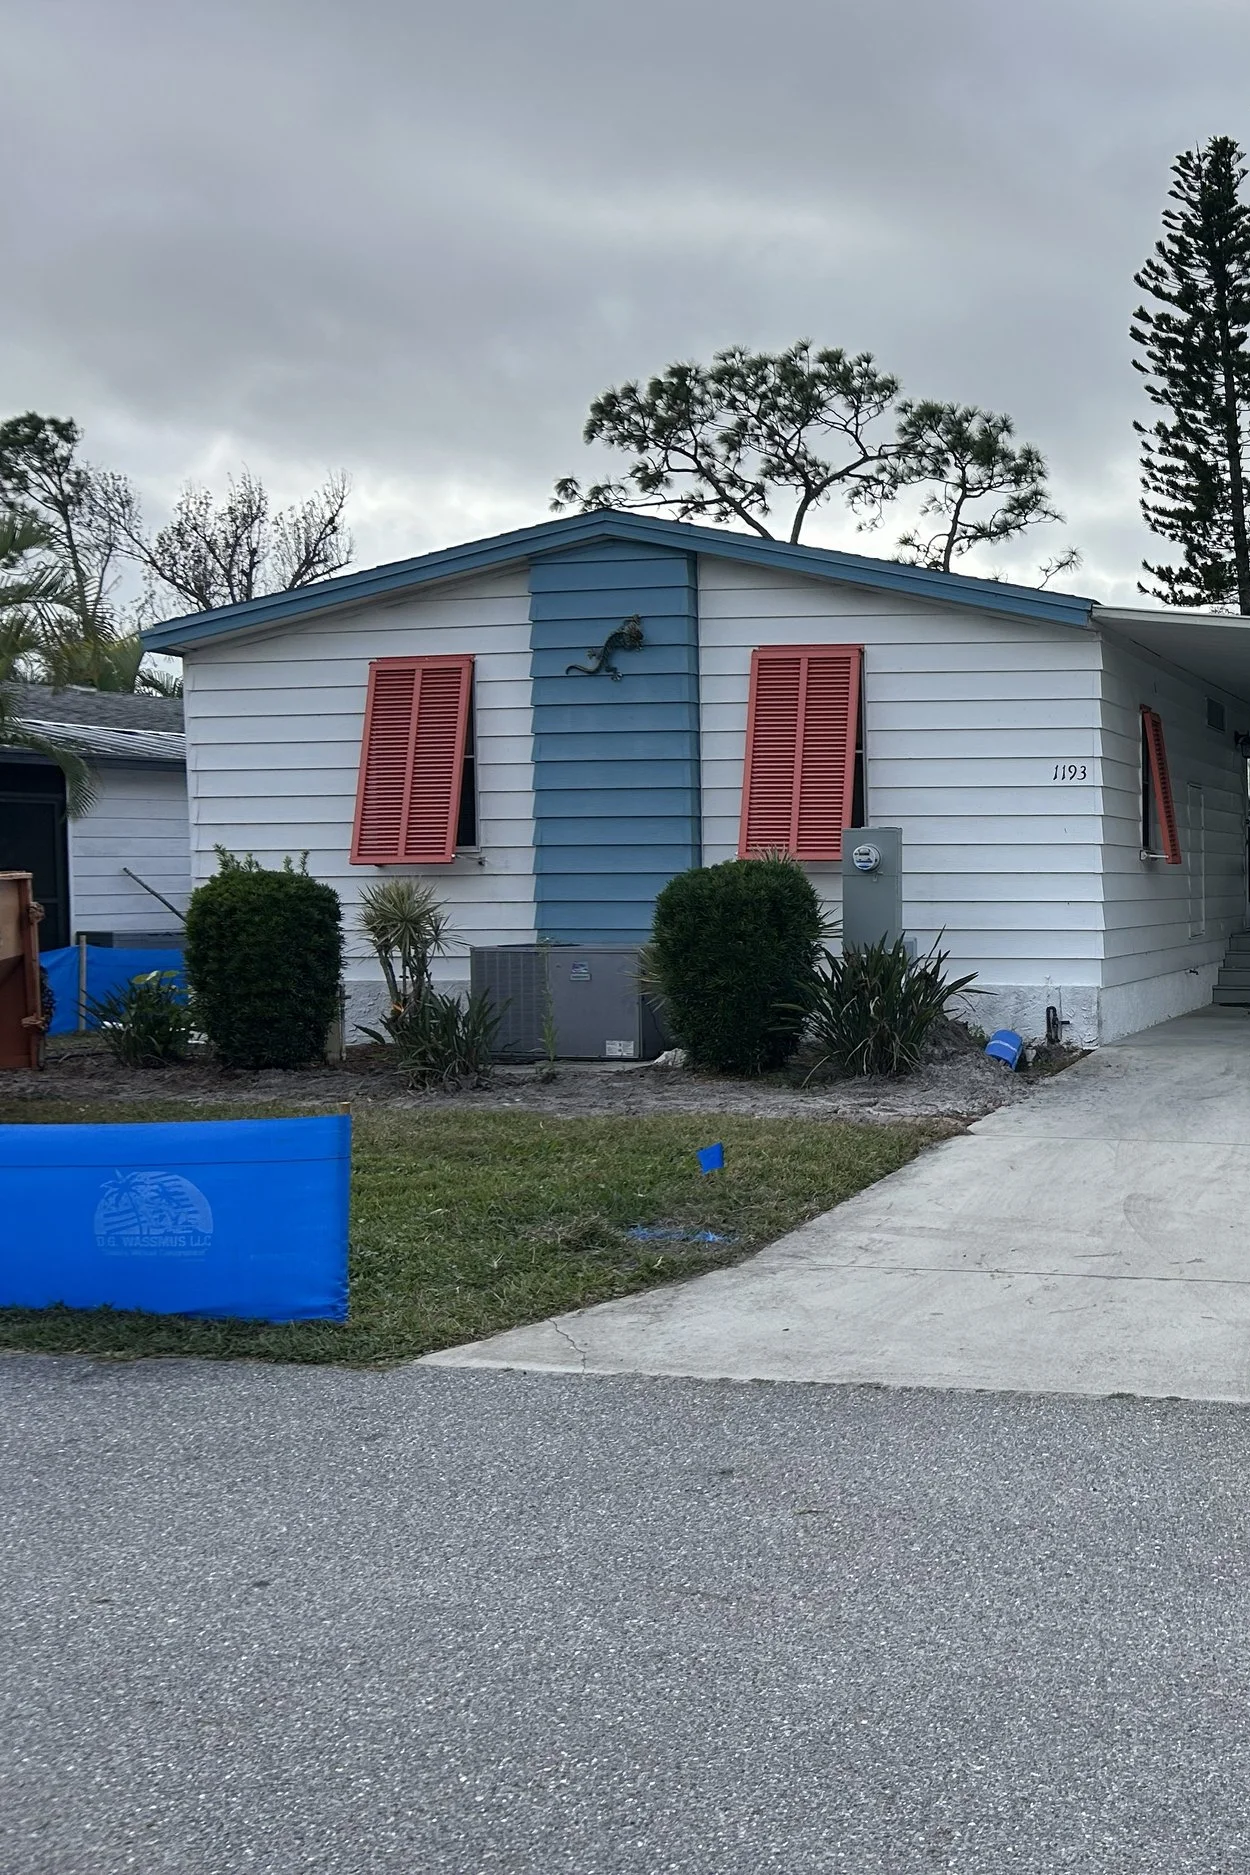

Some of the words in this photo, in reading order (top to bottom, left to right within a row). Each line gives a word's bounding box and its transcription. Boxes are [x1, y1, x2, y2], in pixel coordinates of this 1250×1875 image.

[1052, 764, 1087, 781] 1193
[121, 1235, 186, 1247] WASSMUS
[190, 1235, 212, 1247] LLC
